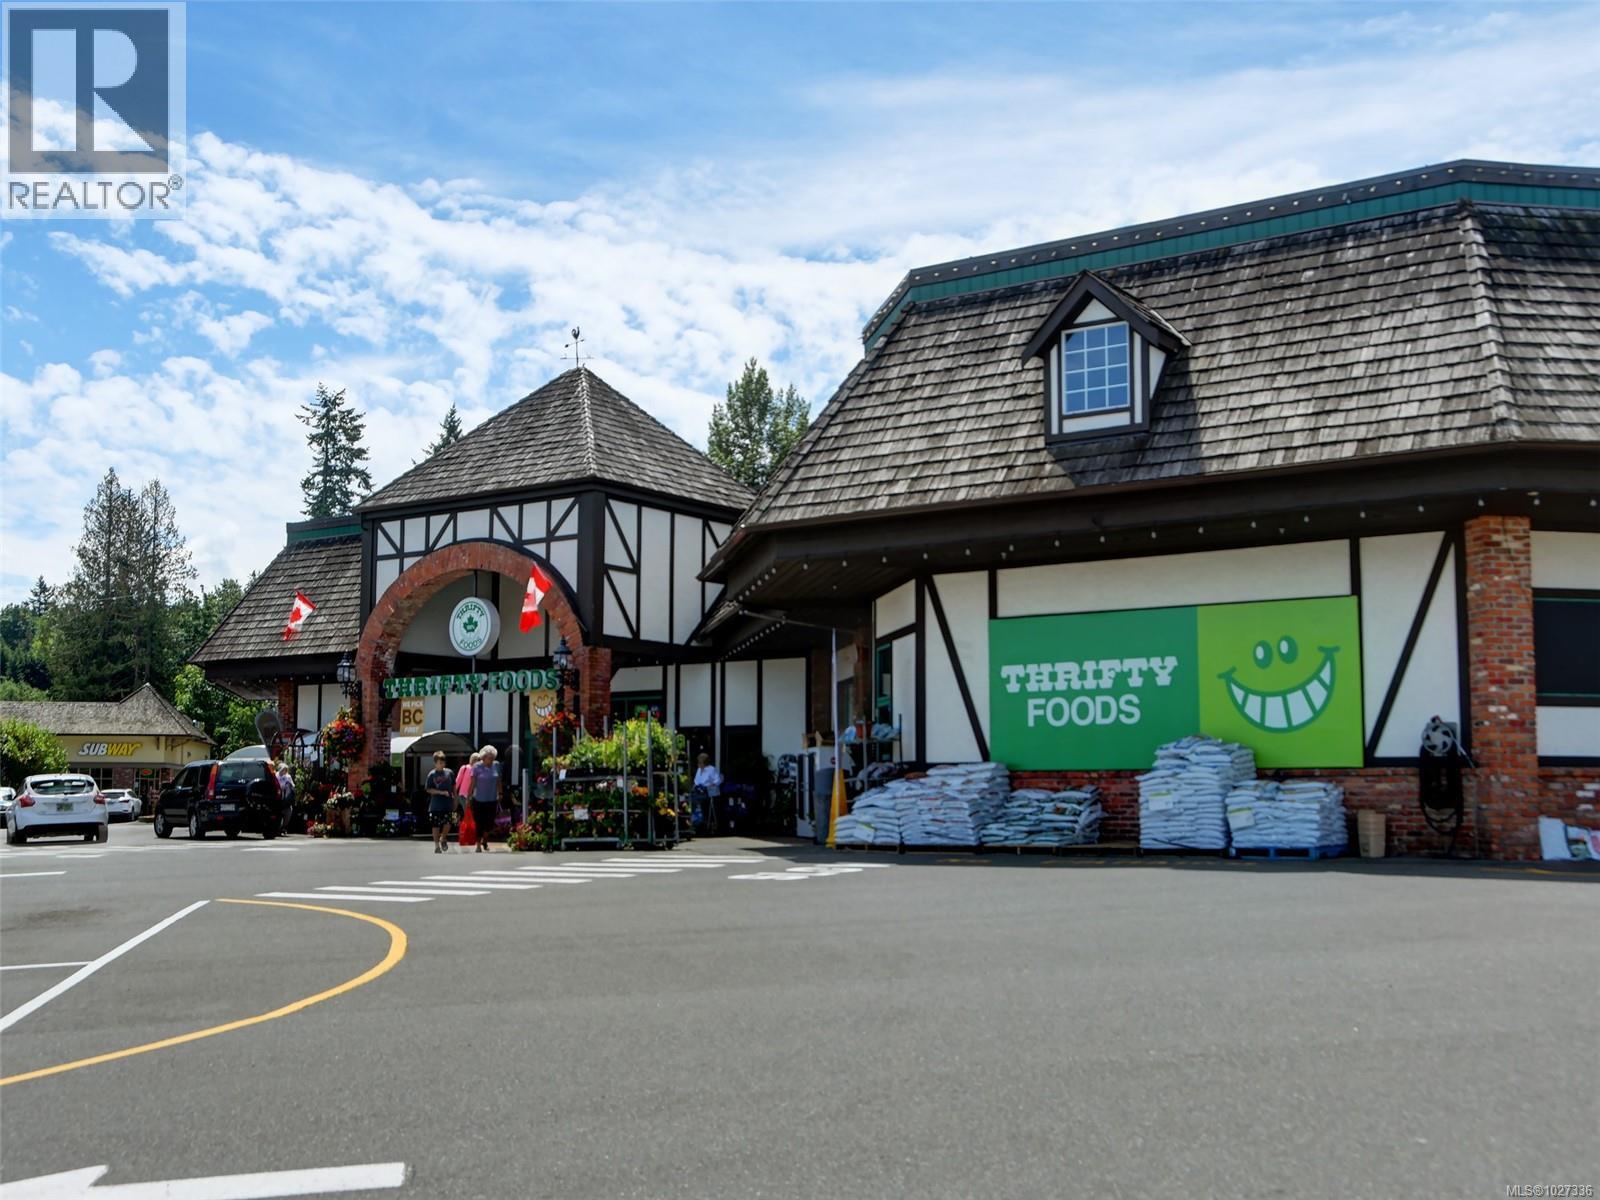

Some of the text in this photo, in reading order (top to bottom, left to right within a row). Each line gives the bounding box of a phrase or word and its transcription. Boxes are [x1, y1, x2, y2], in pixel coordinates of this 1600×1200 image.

[383, 667, 561, 699] THRIFTY FOODS
[1000, 655, 1178, 693] THRIFTY
[402, 709, 424, 725] BC
[1027, 693, 1141, 727] FOODS
[79, 742, 142, 756] SUBWAY
